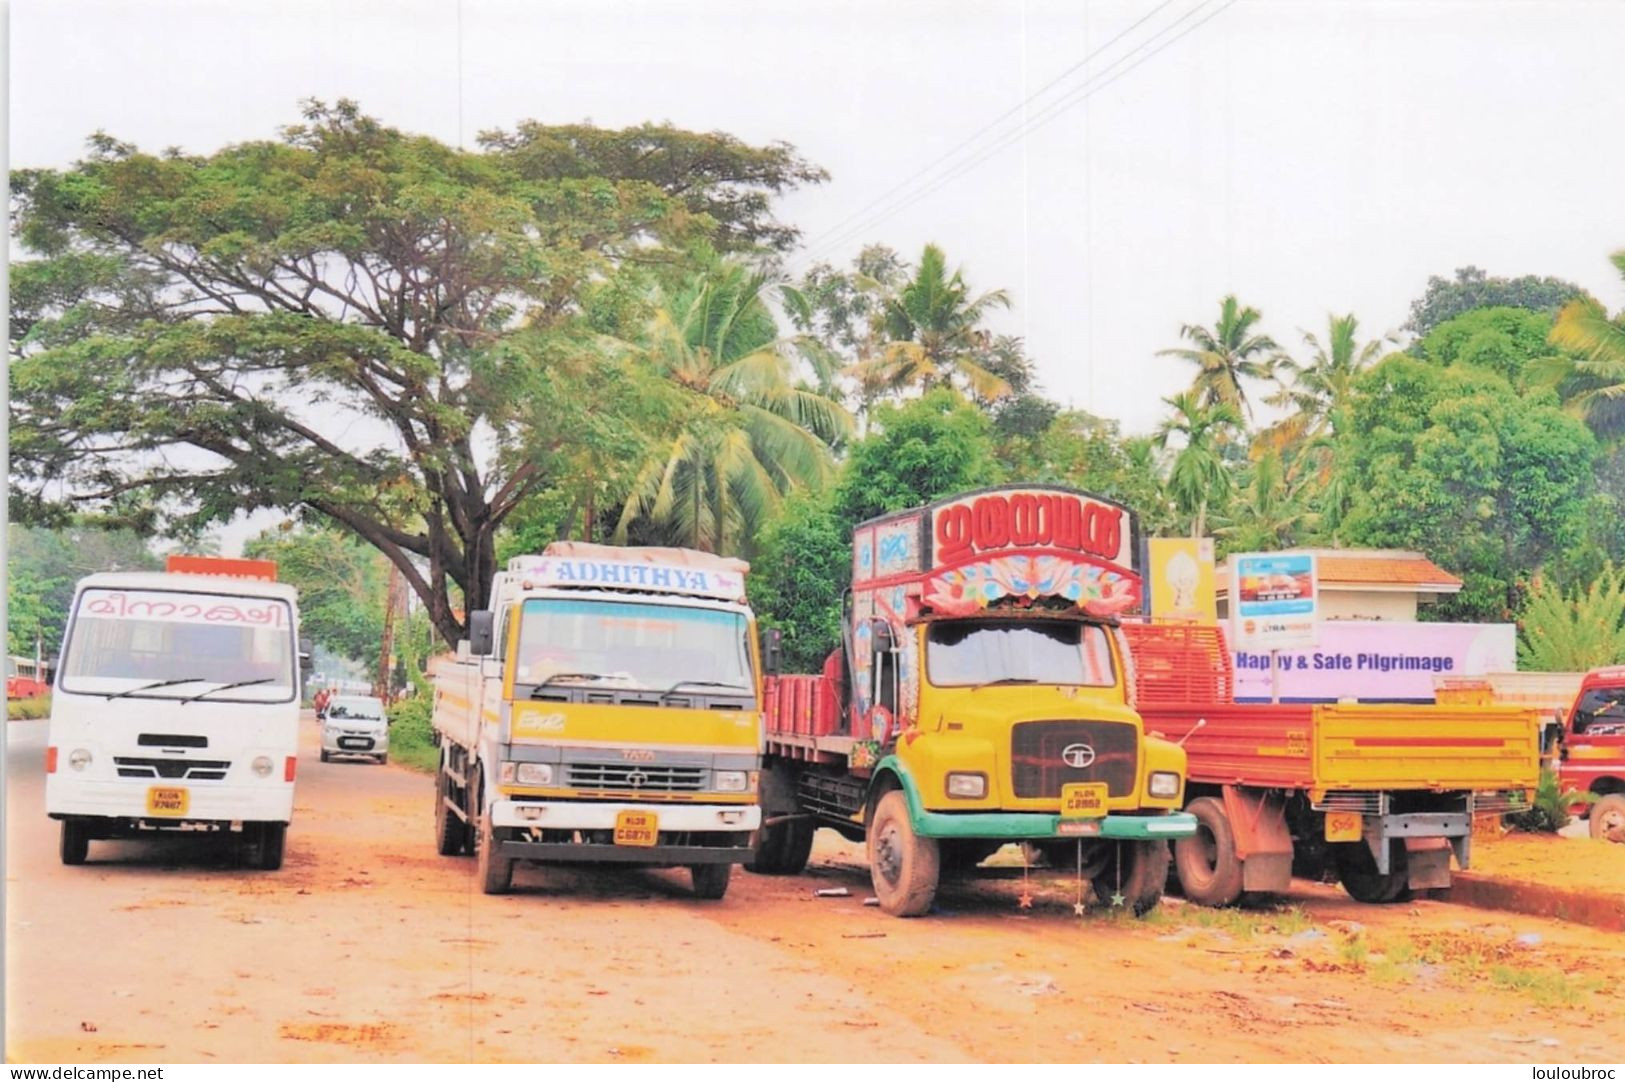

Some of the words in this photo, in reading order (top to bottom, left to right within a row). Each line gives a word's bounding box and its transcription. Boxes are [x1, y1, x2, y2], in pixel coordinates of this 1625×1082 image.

[556, 561, 709, 591] ADHITHYA
[1297, 652, 1309, 670] &
[1313, 652, 1353, 670] Safe
[1357, 653, 1454, 672] Pilgrimage
[622, 749, 656, 762] TATA
